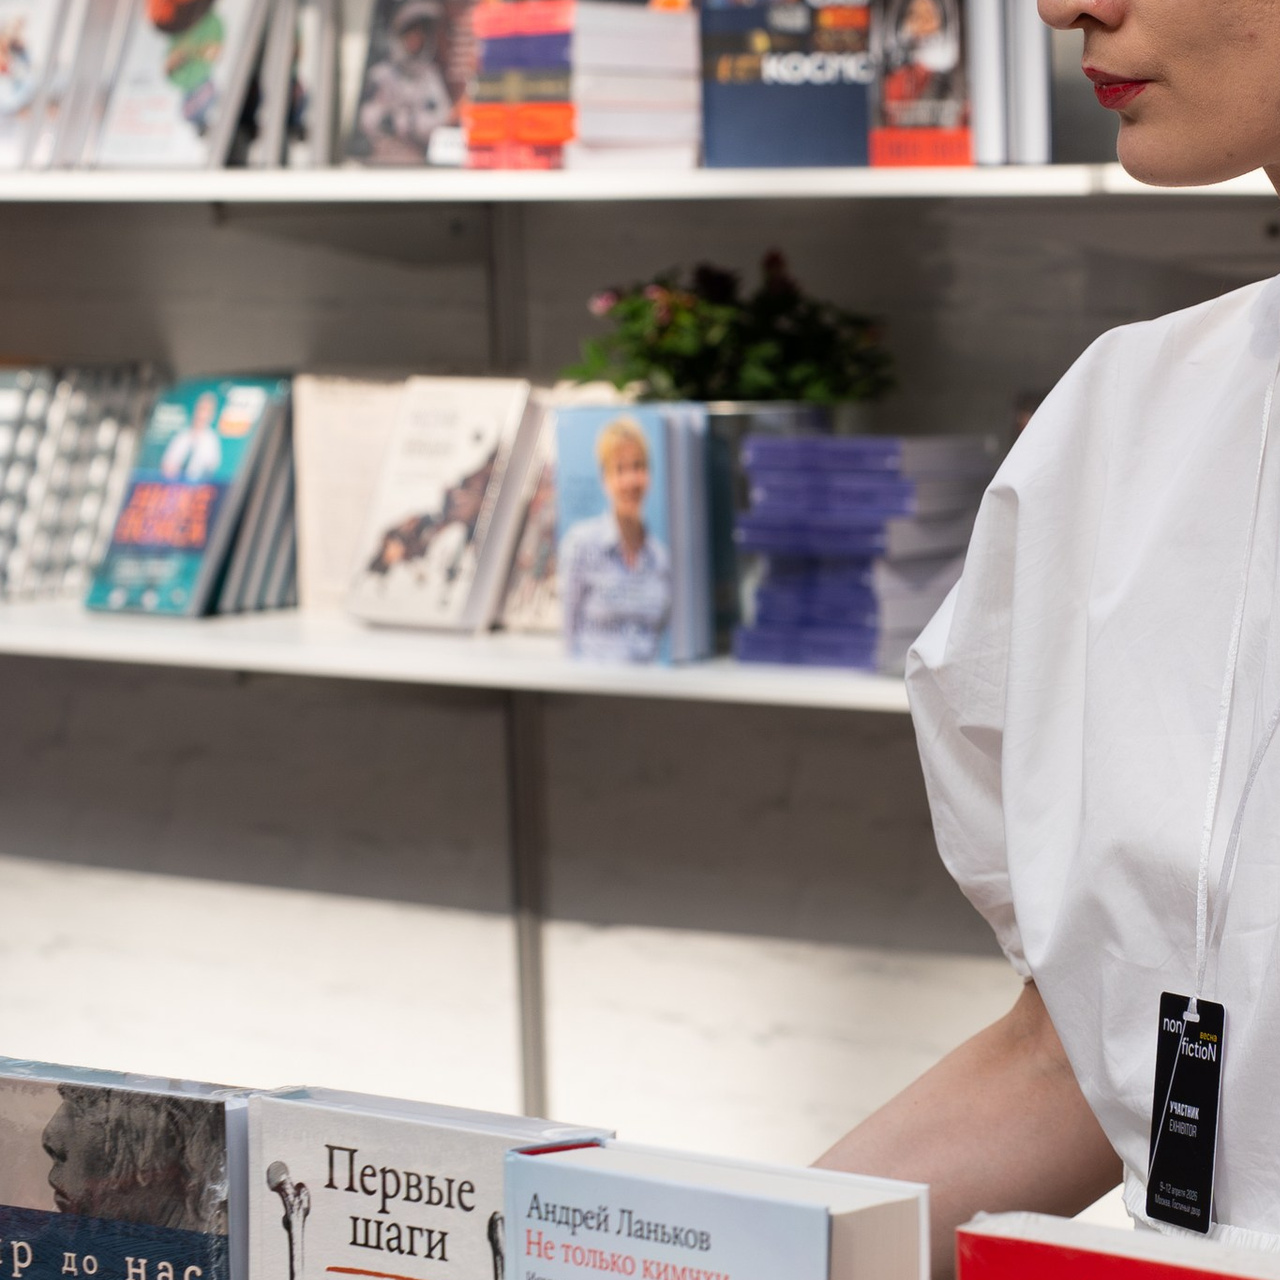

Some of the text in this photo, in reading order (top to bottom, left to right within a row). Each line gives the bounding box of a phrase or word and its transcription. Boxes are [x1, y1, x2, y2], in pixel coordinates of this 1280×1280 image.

[1163, 1016, 1183, 1034] non
[1181, 1036, 1217, 1062] fictioN
[1168, 1118, 1198, 1138] EXHIBITOR
[1169, 1100, 1199, 1121] УЧАСТНИК
[323, 1144, 476, 1215] Первые
[349, 1216, 449, 1261] шаги
[525, 1192, 711, 1252] Андрей Ланьков
[0, 1237, 33, 1278] р
[61, 1251, 99, 1276] до
[525, 1228, 555, 1261] Не
[560, 1242, 637, 1276] только
